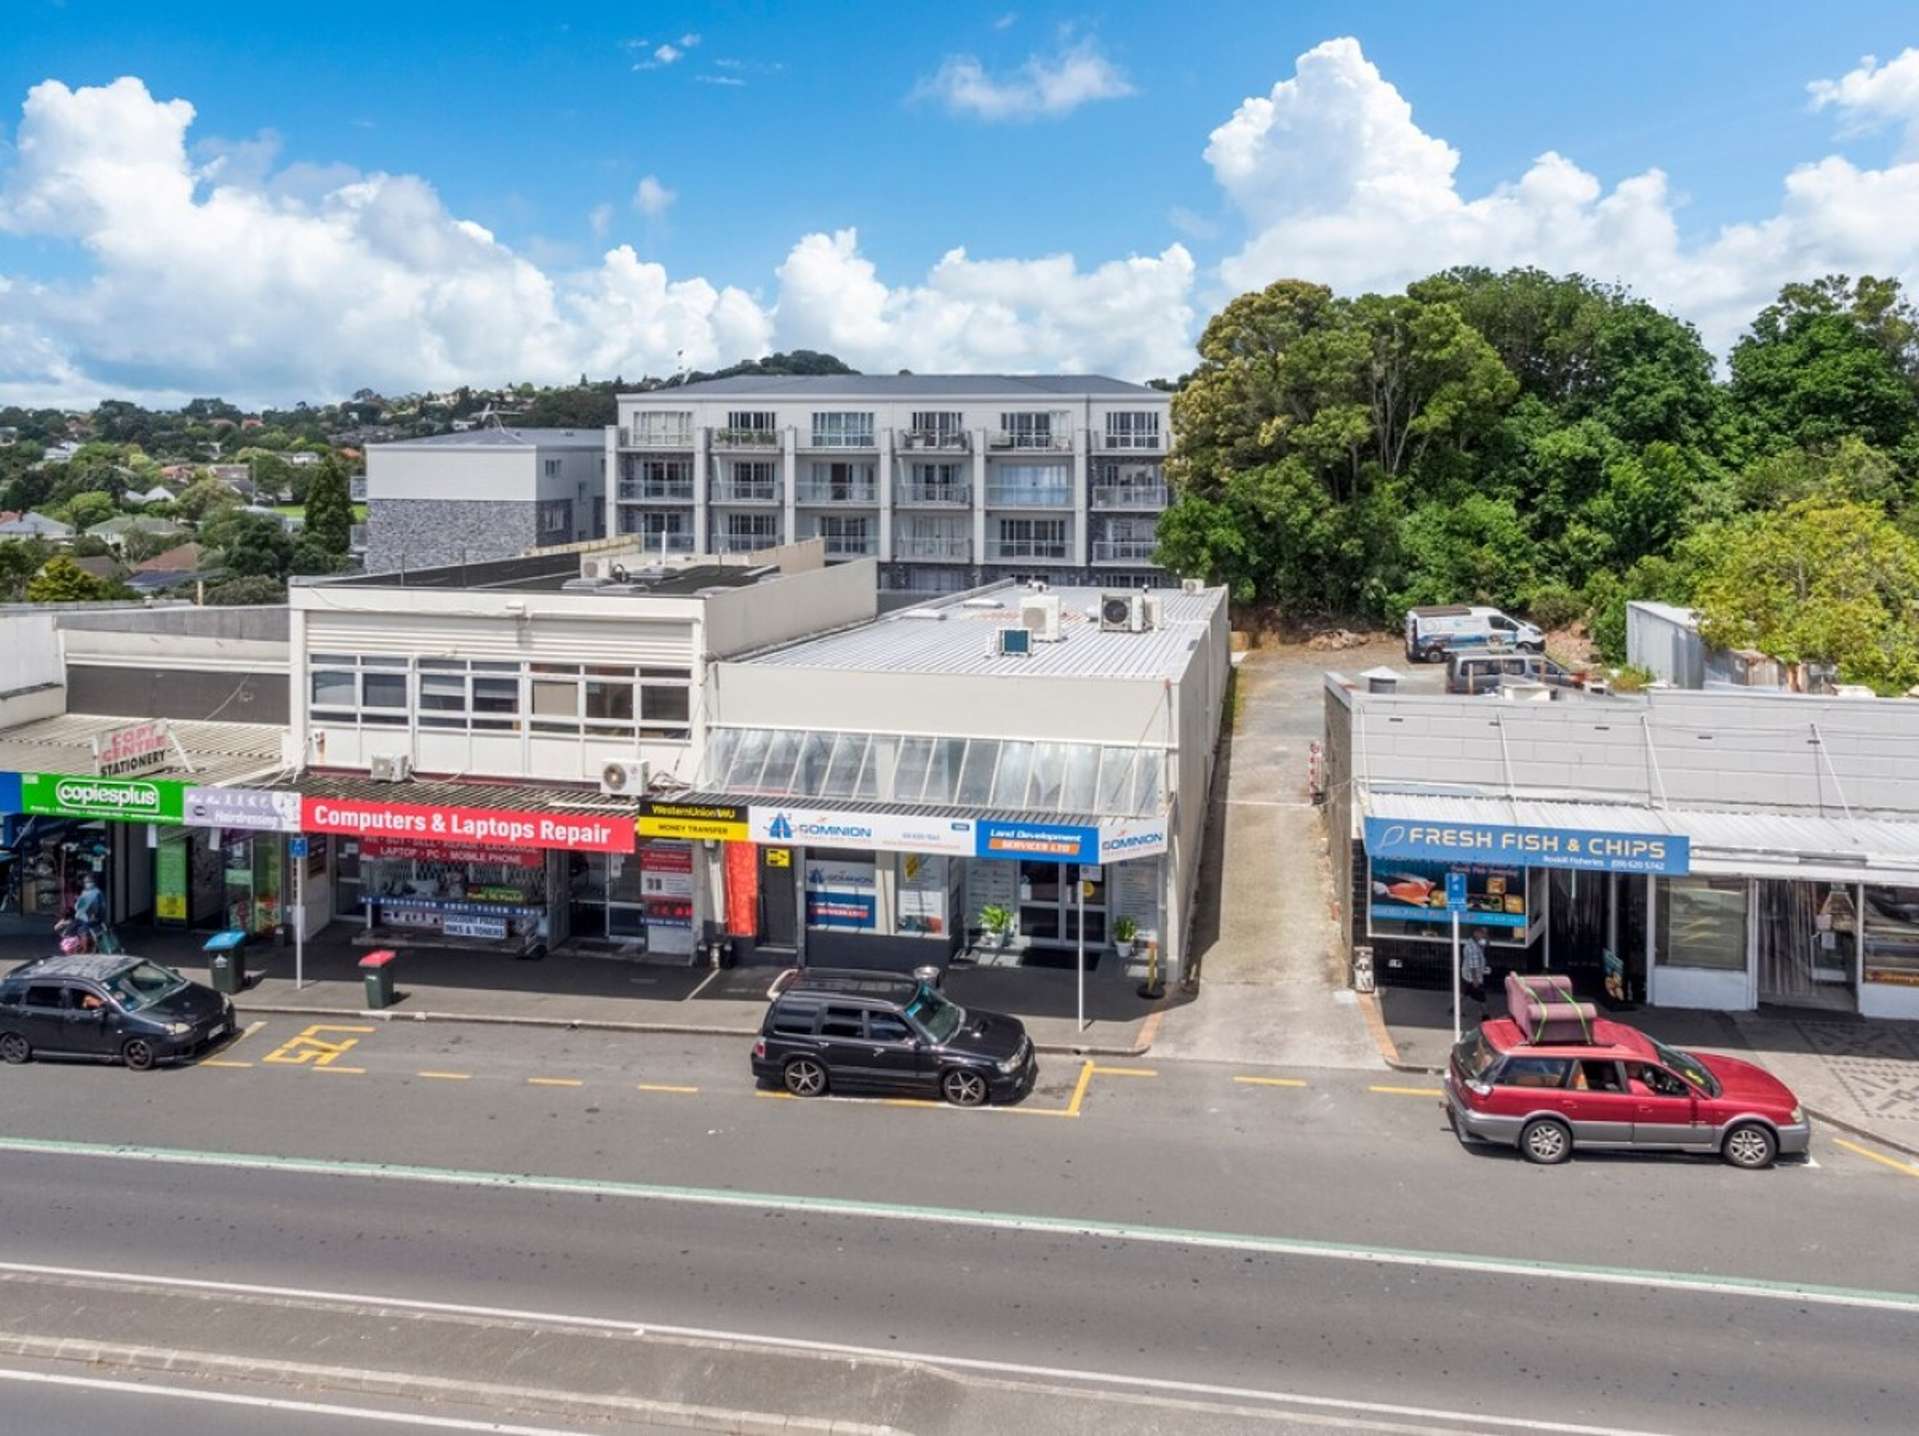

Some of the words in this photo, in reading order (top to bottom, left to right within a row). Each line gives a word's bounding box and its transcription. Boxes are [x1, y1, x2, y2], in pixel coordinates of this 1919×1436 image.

[101, 748, 165, 776] STATIONERY
[59, 783, 156, 807] copiesplus
[314, 804, 426, 832] Computers
[431, 813, 446, 833] &
[451, 814, 535, 840] Laptops
[540, 820, 611, 845] Repair
[658, 824, 685, 832] MONEY
[688, 825, 728, 835] TRANSFER
[990, 828, 1015, 838] Land
[1016, 830, 1082, 842] Development
[1409, 827, 1492, 848] FRESH
[1502, 832, 1559, 852] FISH
[1567, 837, 1580, 852] &
[1588, 837, 1665, 859] CHIPS
